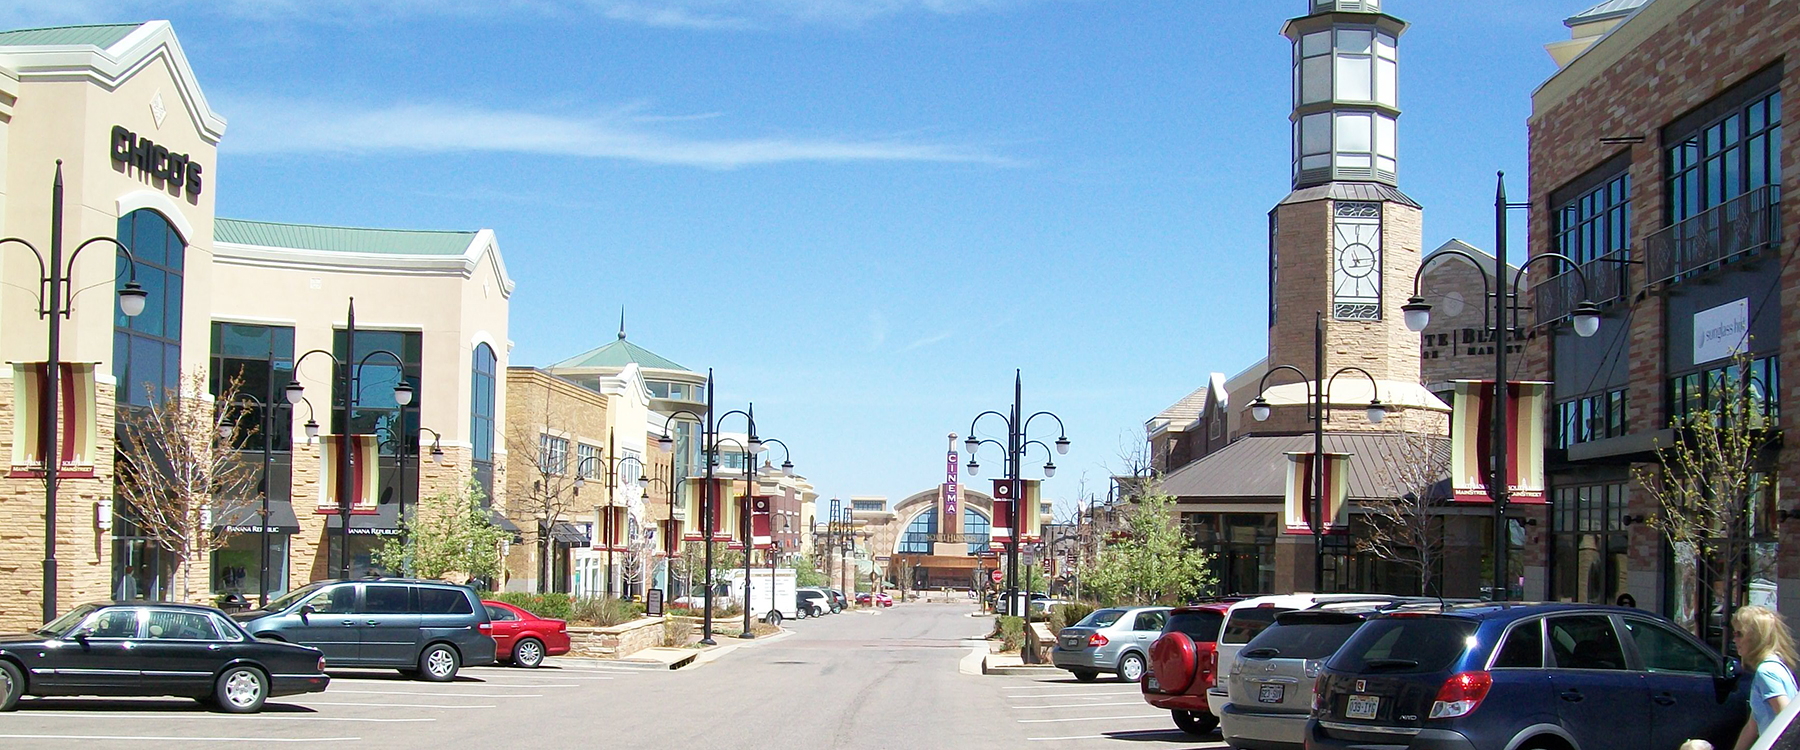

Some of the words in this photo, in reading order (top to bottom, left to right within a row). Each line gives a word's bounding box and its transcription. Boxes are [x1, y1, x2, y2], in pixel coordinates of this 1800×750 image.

[110, 124, 203, 196] CHICO'S
[1462, 328, 1527, 344] BLAK
[1705, 321, 1734, 343] sunglass
[1467, 345, 1523, 355] MARET
[947, 454, 957, 512] CINEMA
[252, 525, 280, 533] REPBLIC
